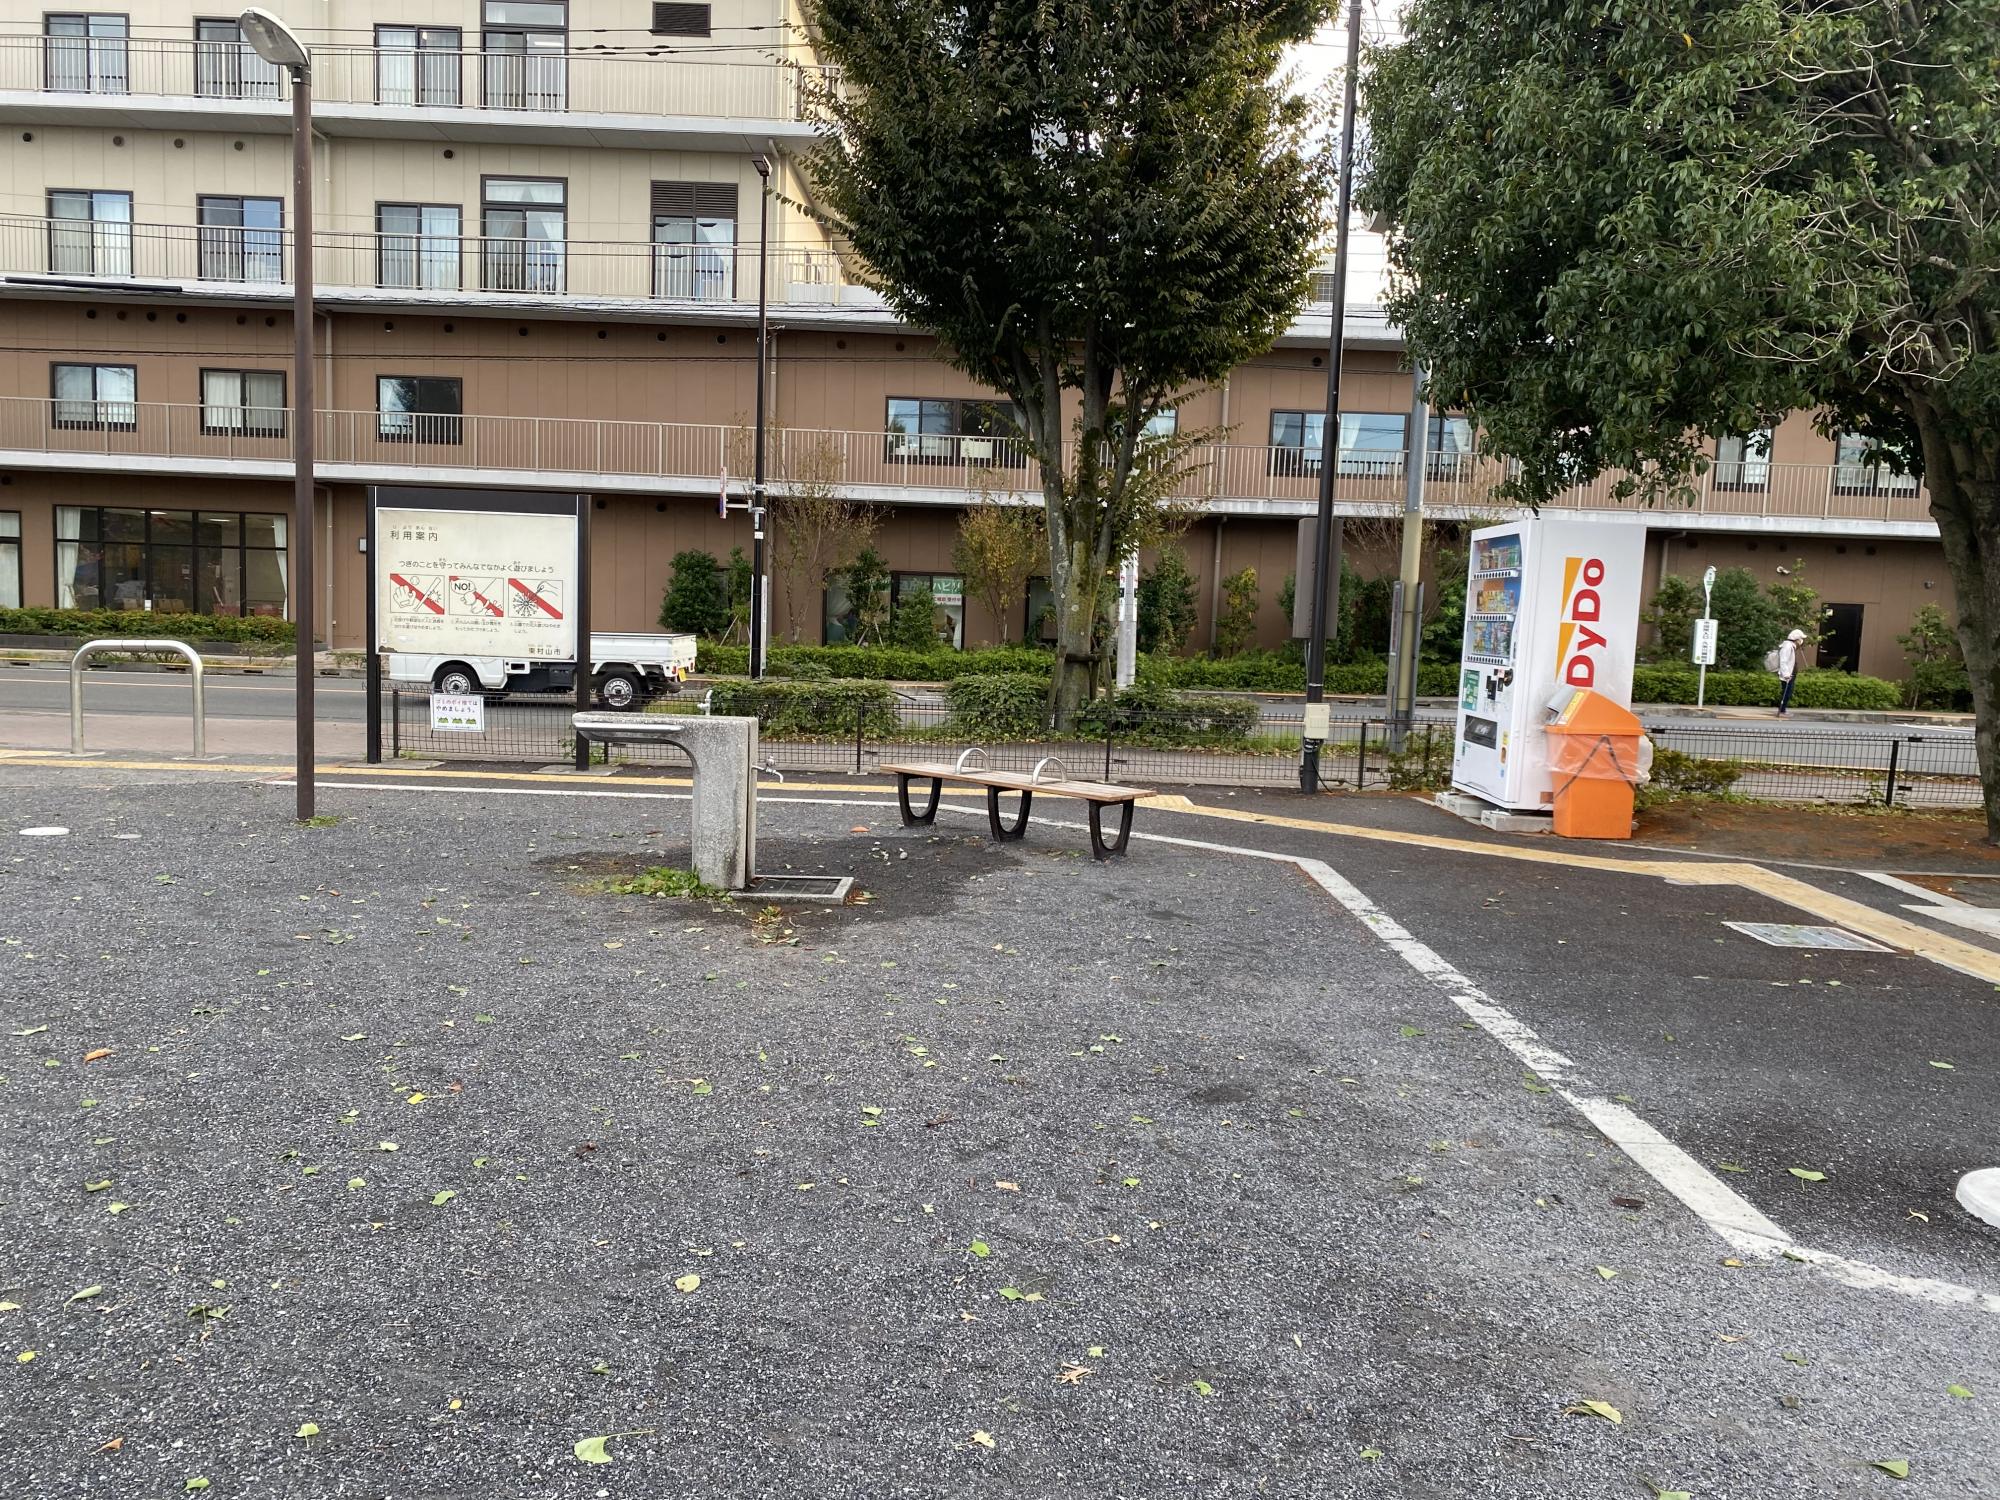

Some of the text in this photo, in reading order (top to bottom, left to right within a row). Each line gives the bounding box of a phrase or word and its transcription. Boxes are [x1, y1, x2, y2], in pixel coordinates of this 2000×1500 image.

[389, 530, 438, 542] 利用案内
[454, 582, 471, 592] NO!
[1566, 558, 1606, 687] DyDo
